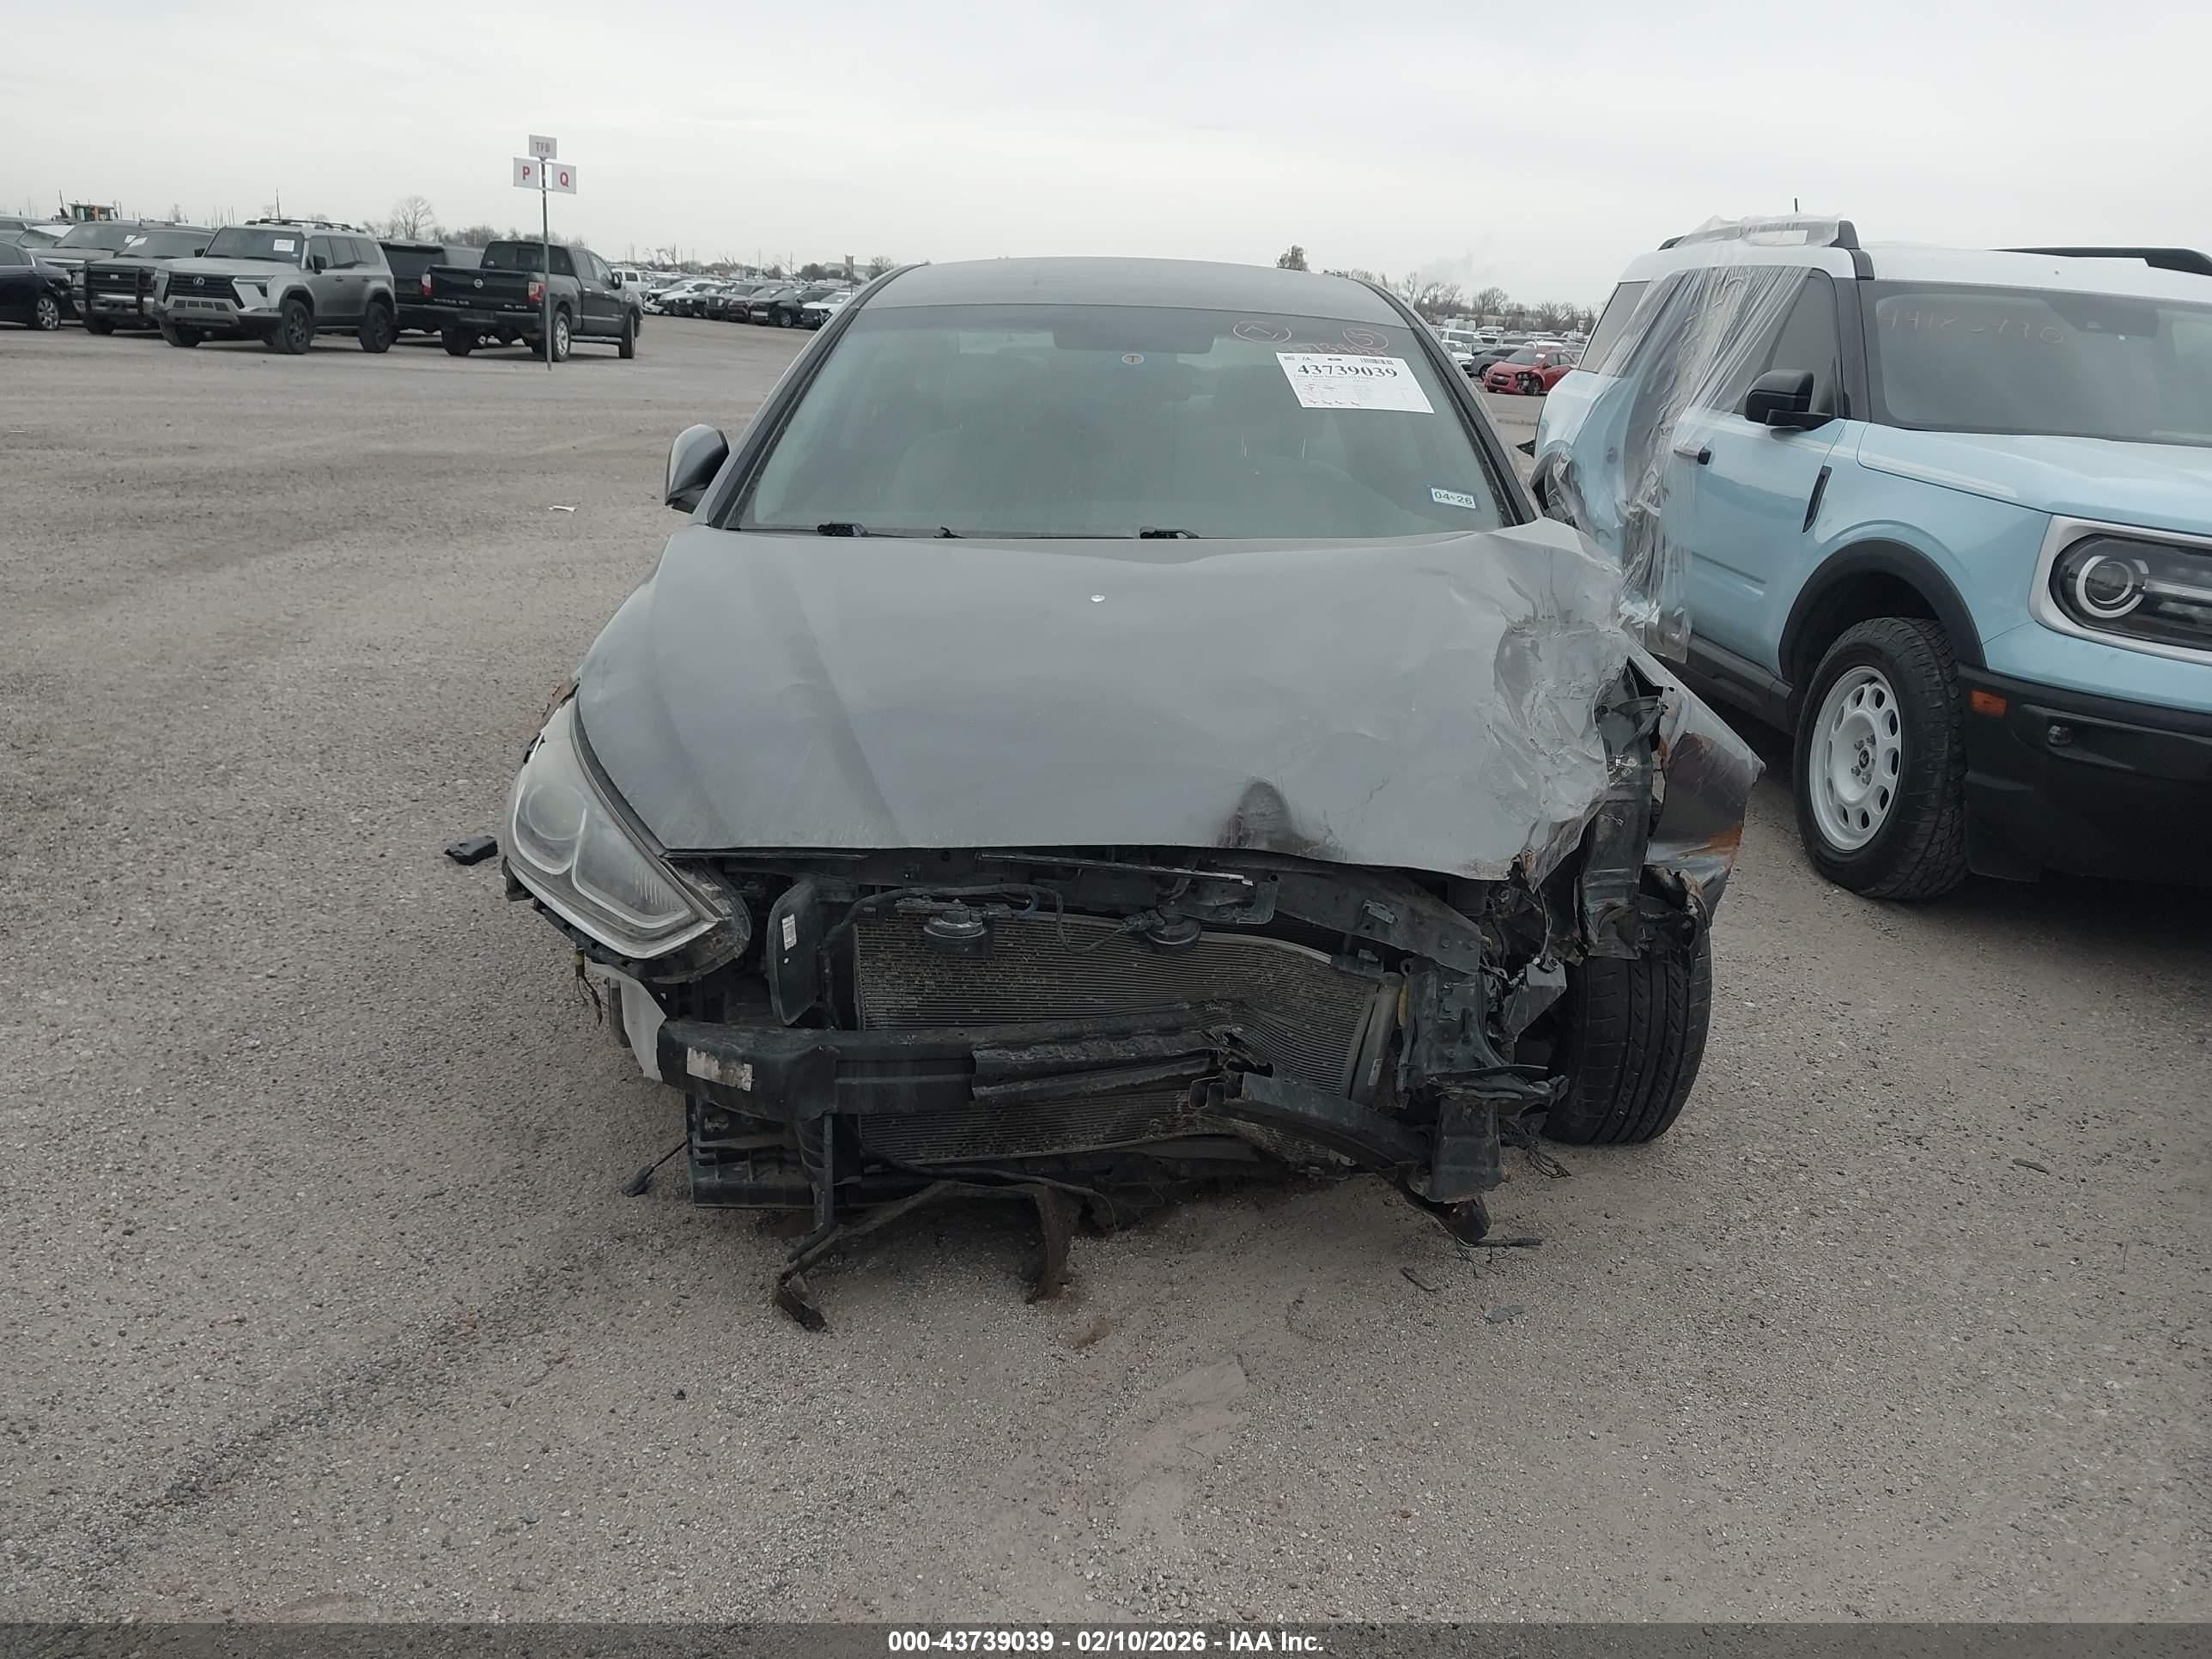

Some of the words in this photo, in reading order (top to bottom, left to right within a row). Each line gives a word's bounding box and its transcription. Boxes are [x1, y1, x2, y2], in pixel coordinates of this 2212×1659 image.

[522, 166, 531, 180] P
[560, 172, 569, 187] Q
[1297, 364, 1398, 379] 43739039
